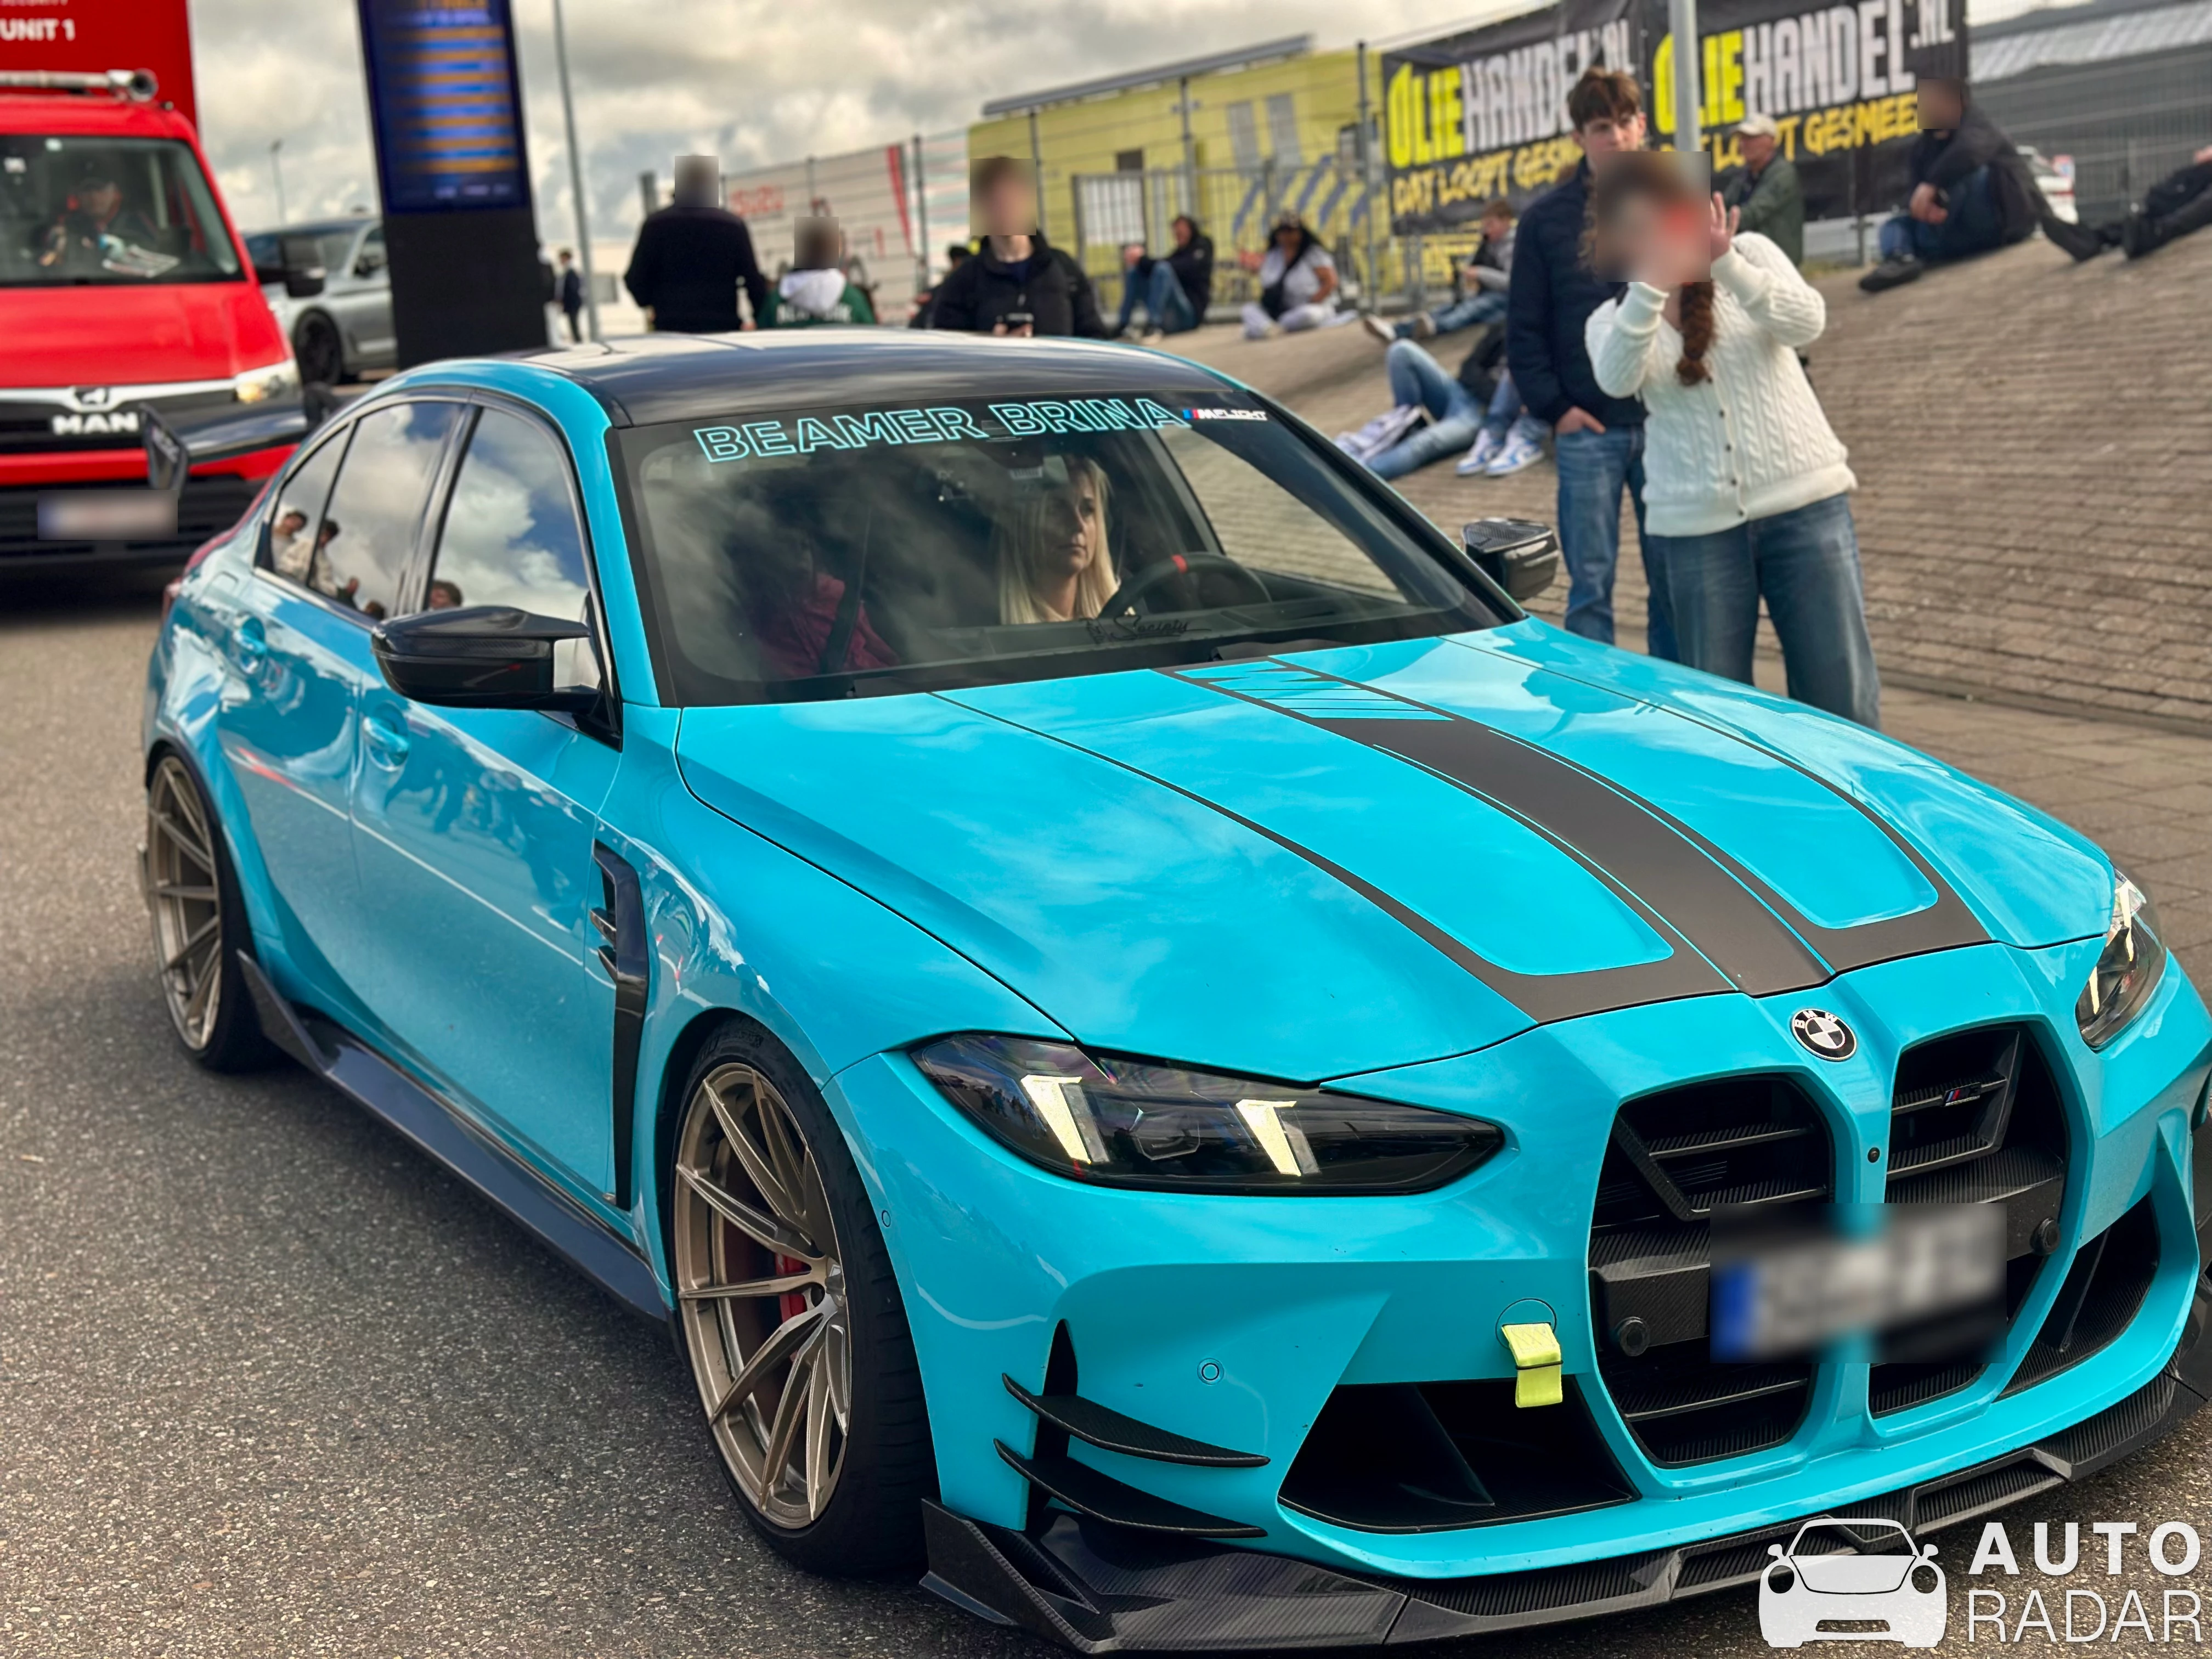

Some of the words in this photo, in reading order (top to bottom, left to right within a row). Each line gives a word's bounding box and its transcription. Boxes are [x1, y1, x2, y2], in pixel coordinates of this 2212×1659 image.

[0, 18, 60, 41] UNIT
[61, 18, 76, 42] 1
[1654, 0, 1954, 134] OIEHANDEL.NL
[1803, 91, 1923, 157] GESMEE
[53, 412, 139, 436] MAN
[693, 407, 990, 462] BEAMER
[988, 399, 1192, 436] BRINA
[1794, 1010, 1838, 1029] BMW
